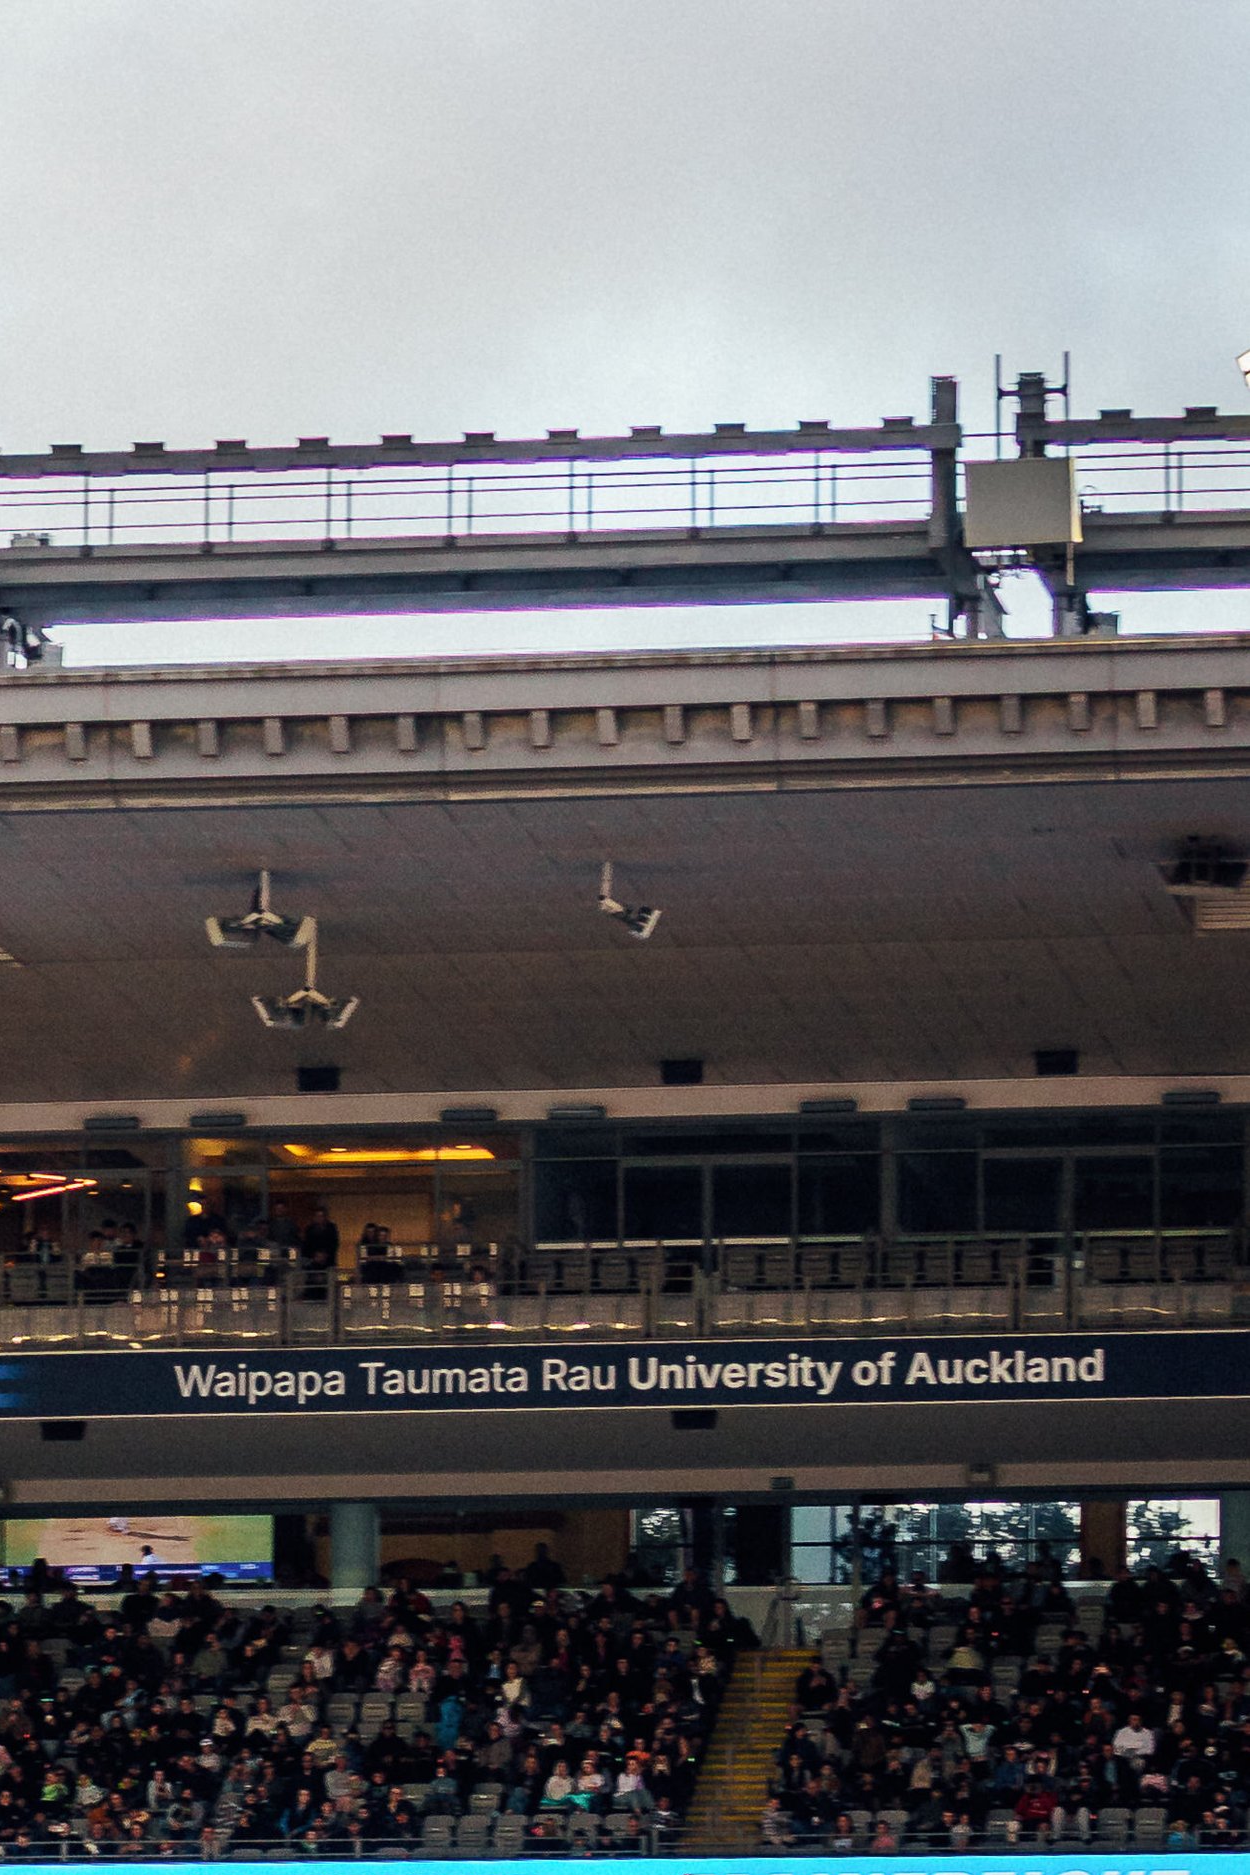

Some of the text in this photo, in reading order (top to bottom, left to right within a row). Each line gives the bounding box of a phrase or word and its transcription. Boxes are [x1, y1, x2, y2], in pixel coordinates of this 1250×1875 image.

[174, 1348, 1105, 1405] Waipapa Taumata Rau University of Auckland
